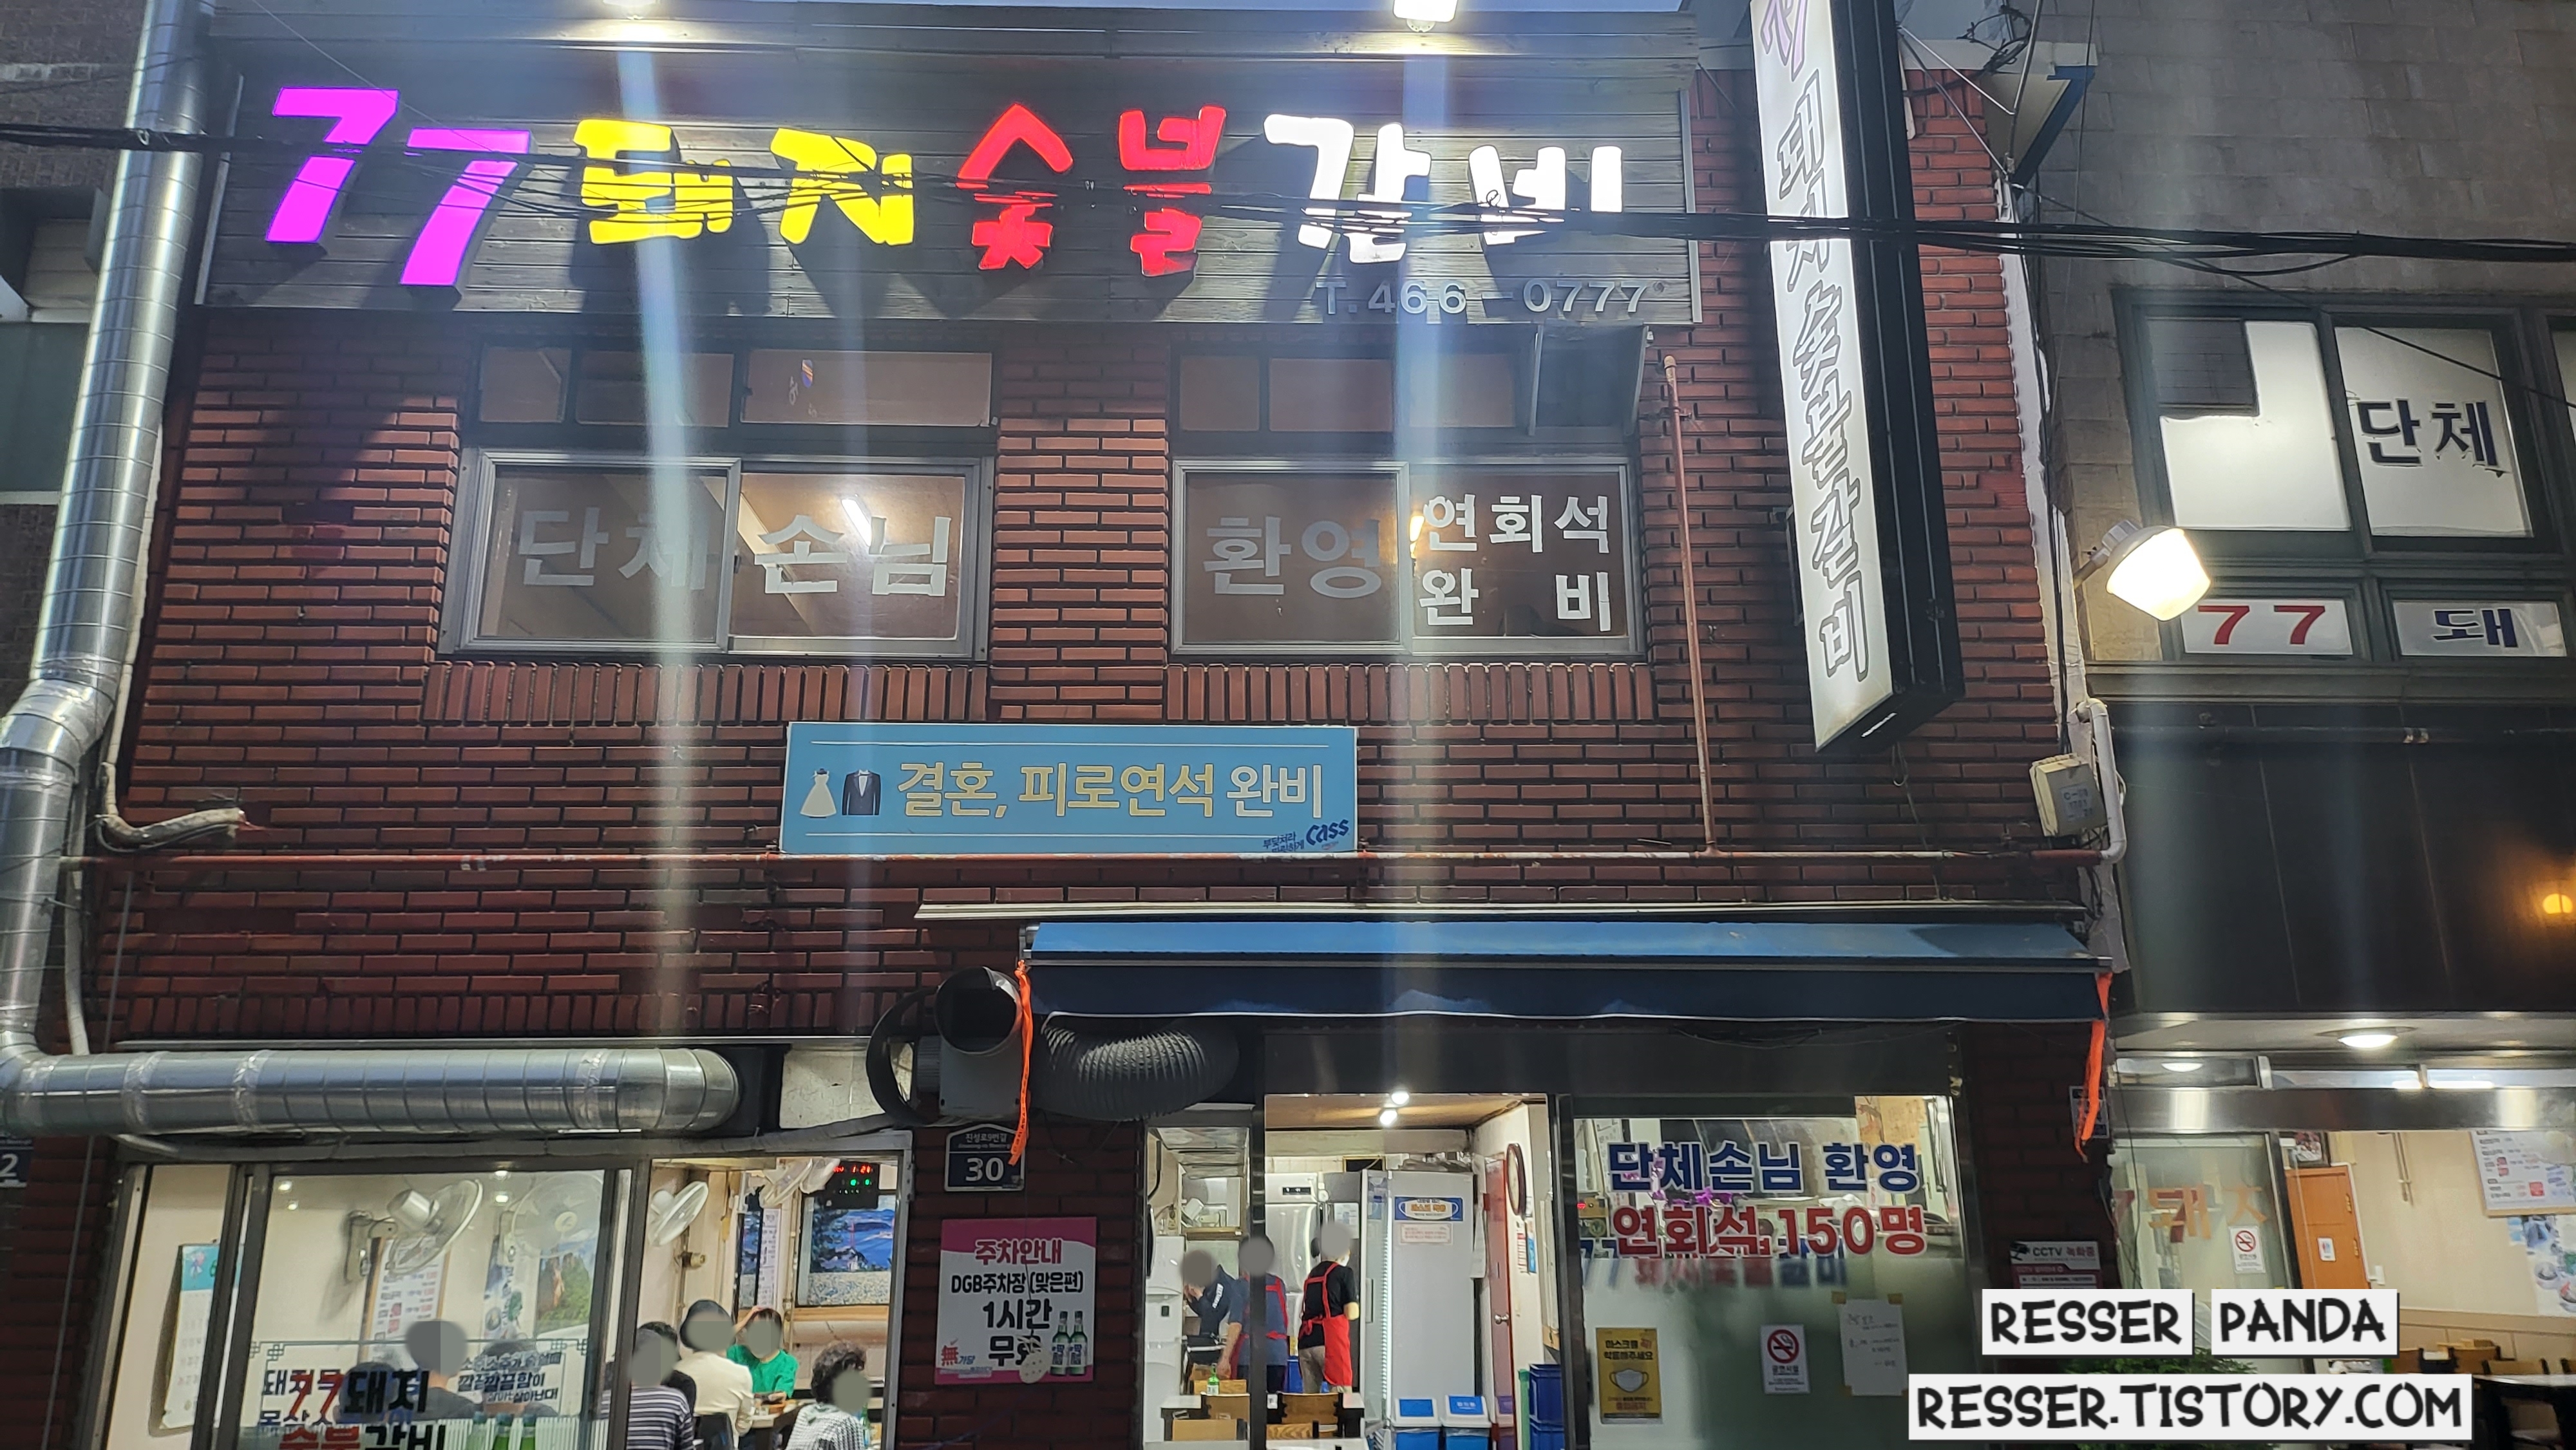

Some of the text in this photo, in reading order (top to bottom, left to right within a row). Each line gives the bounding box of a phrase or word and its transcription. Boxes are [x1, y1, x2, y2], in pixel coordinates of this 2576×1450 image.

[265, 87, 531, 285] 77
[574, 118, 914, 245] 돼지
[956, 103, 1227, 277] 숯불
[2357, 398, 2499, 466] 단체
[1422, 493, 1610, 555] 연회석
[517, 507, 952, 598] 단체 손님
[1203, 516, 1382, 599] 환영
[2432, 608, 2519, 648] 돼
[896, 761, 1323, 820] 결혼, 피로연석 완비
[965, 1157, 1004, 1182] 30
[1611, 1143, 1918, 1192] 단체손님 환영
[974, 1239, 1063, 1265] 주차안내
[1613, 1205, 1927, 1257] 연회석 150명
[2033, 1247, 2062, 1256] CCTV
[983, 1298, 1052, 1330] 1시간
[343, 1370, 430, 1414] 돼지
